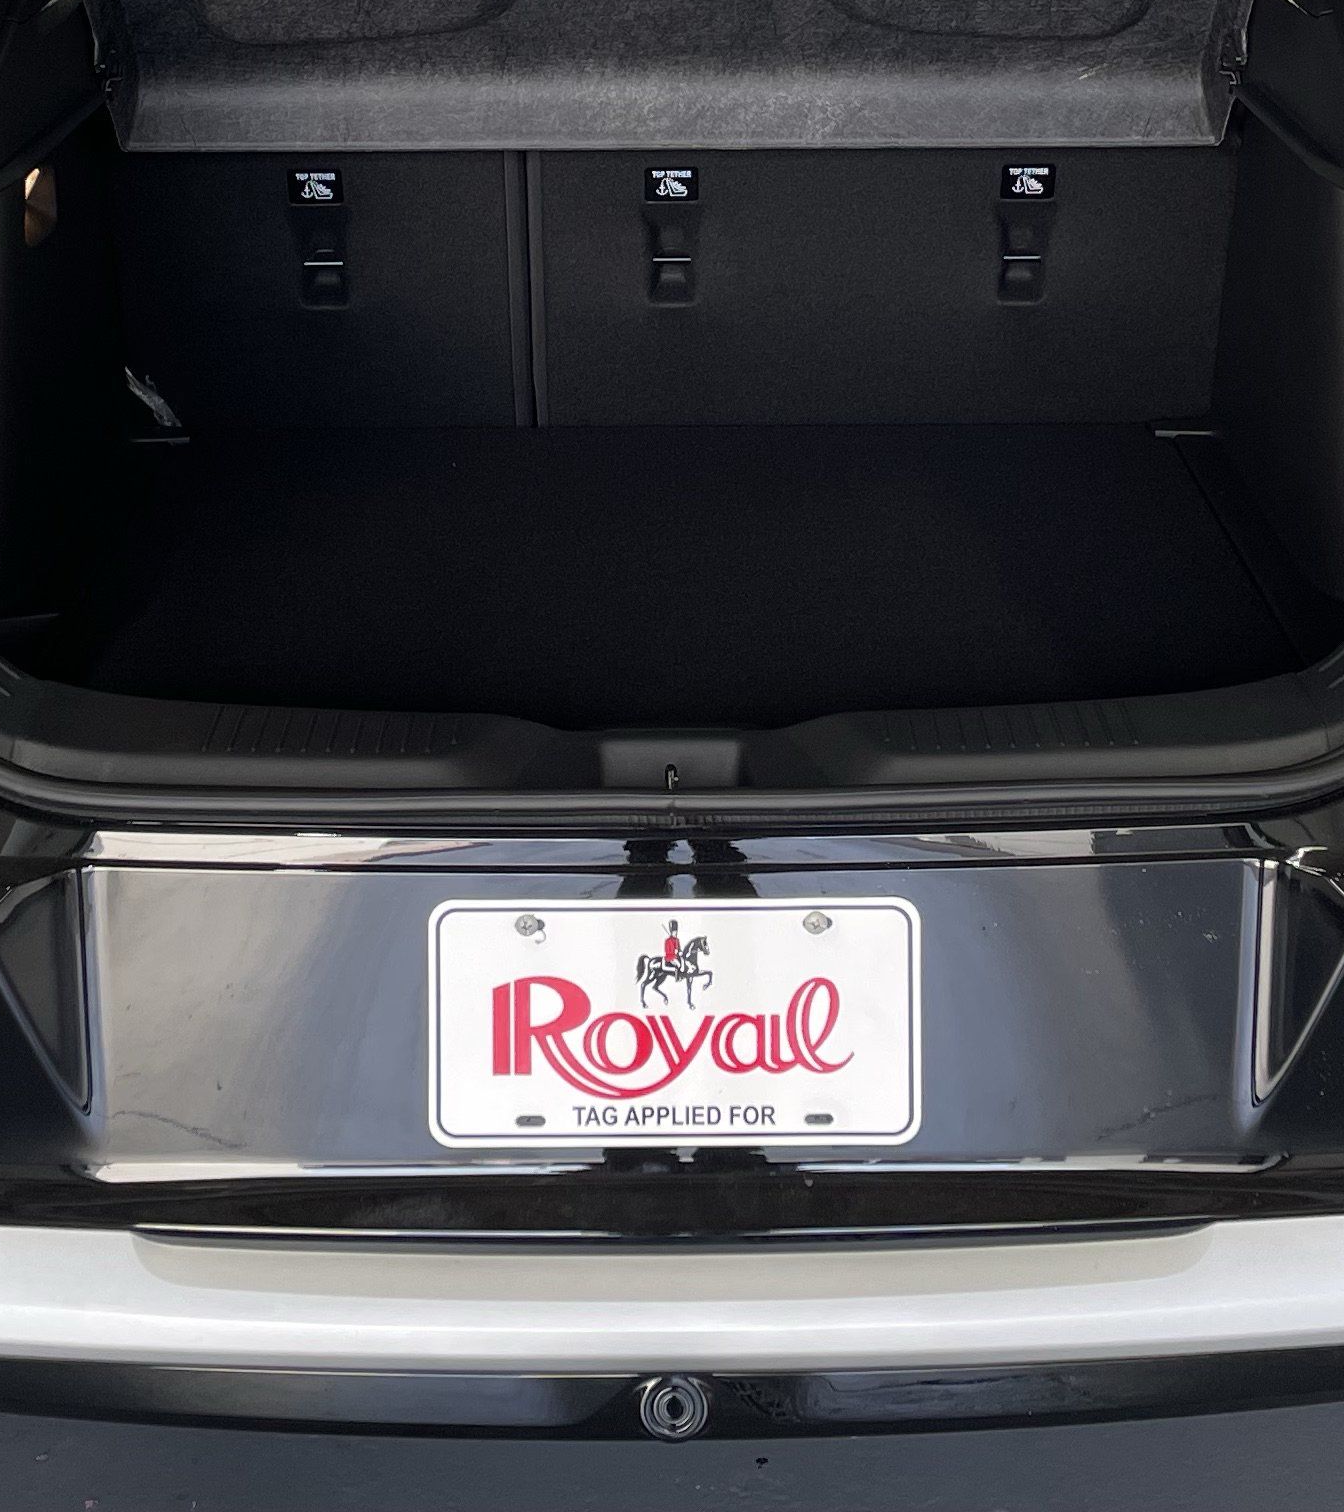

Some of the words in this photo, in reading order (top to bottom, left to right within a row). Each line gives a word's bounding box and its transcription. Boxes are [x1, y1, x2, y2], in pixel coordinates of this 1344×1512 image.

[651, 170, 665, 178] TOP
[666, 170, 692, 178] TETHER
[1009, 167, 1023, 175] TOP
[1023, 167, 1049, 175] TETHER
[295, 172, 309, 181] TOP
[309, 172, 336, 181] TETHER
[492, 975, 854, 1099] Royal
[572, 1105, 618, 1126] TAG
[625, 1105, 721, 1126] APPLIED
[730, 1105, 776, 1126] FOR
